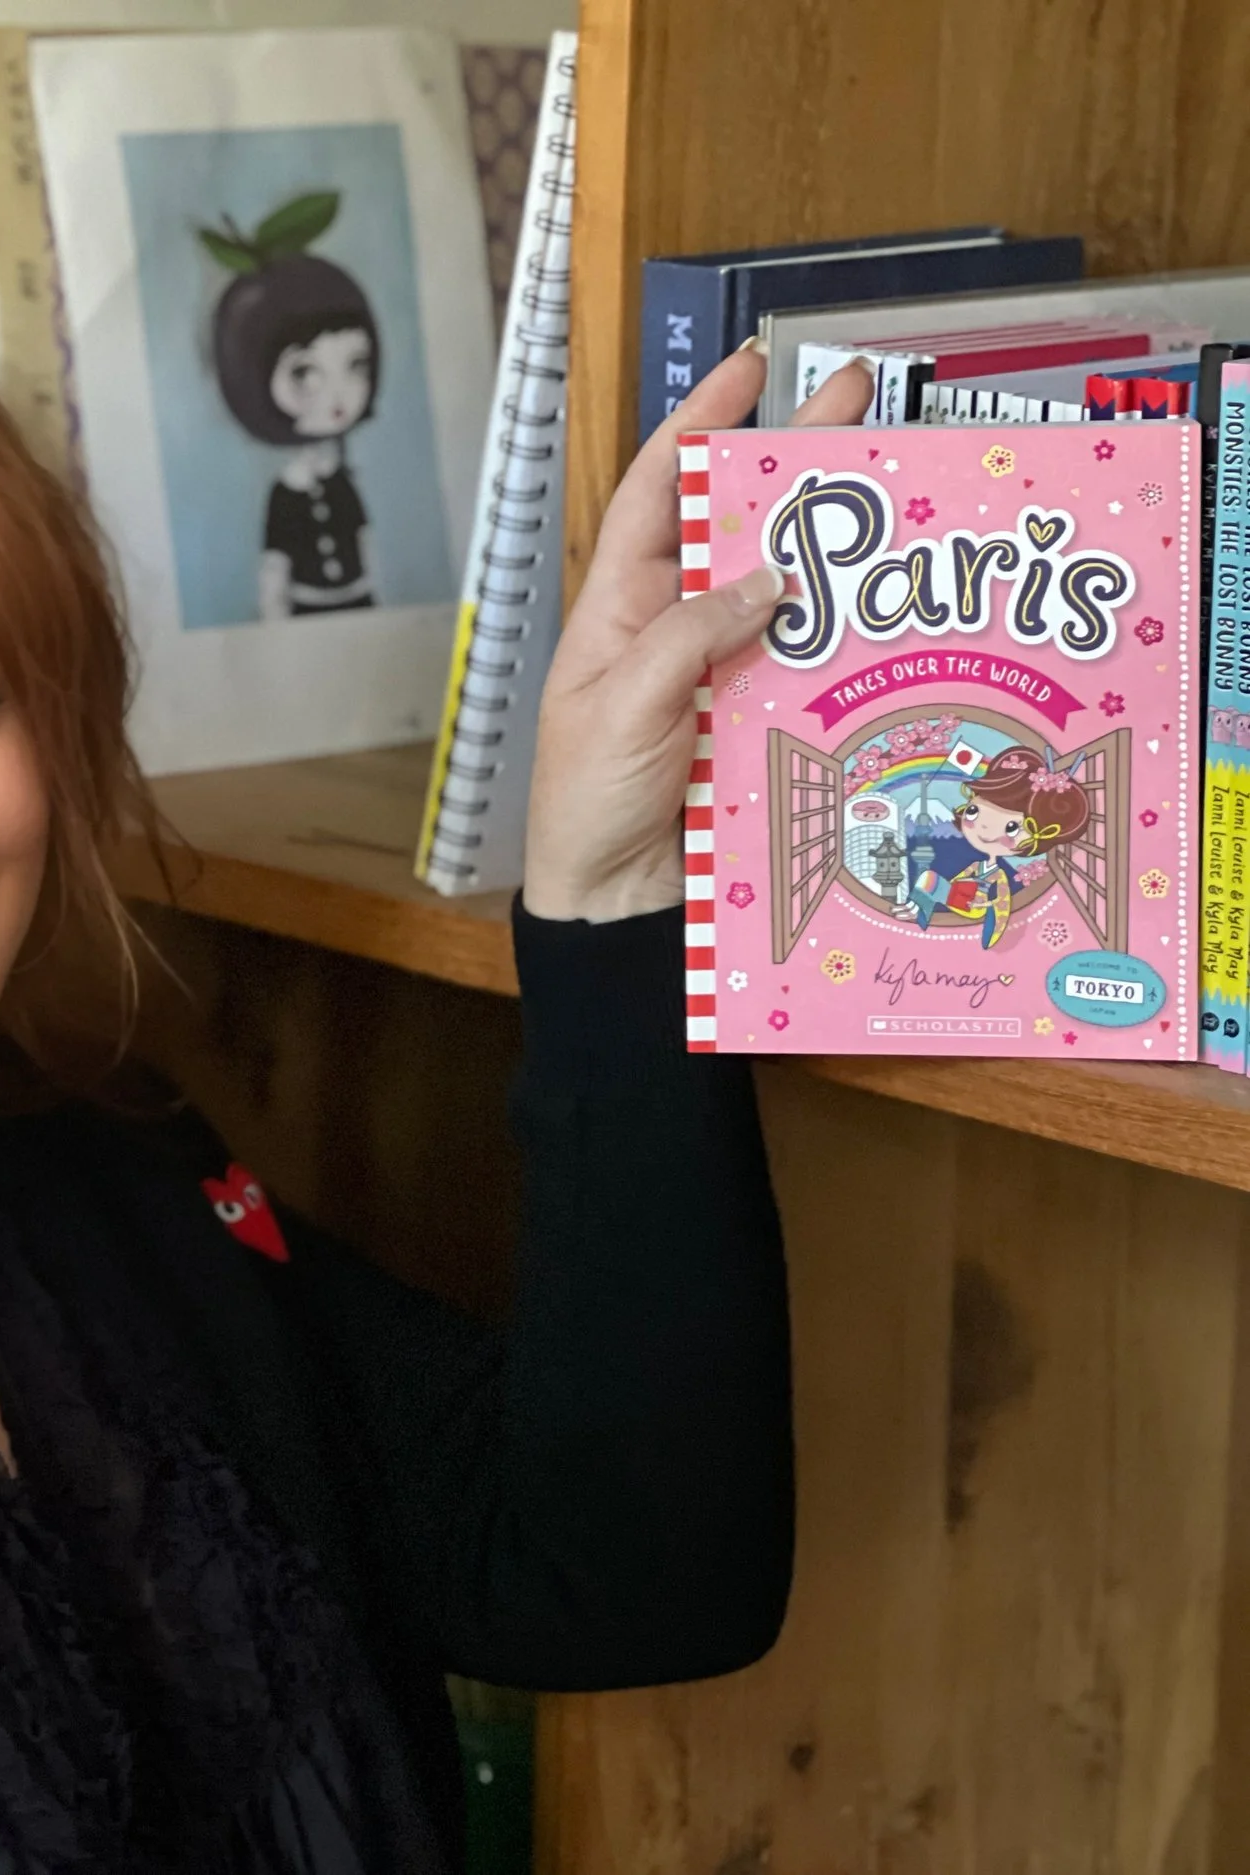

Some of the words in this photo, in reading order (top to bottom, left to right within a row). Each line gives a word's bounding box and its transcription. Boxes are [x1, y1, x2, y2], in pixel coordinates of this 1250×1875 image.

[1221, 401, 1246, 514] MONSTIES:
[1220, 522, 1240, 554] THE
[765, 476, 1129, 662] Paris
[1218, 563, 1239, 611] LOST
[1214, 617, 1236, 691] BUNNY
[831, 669, 887, 707] TAKES
[892, 660, 939, 682] OVER
[945, 656, 982, 677] THE
[989, 662, 1052, 703] WORLD
[1212, 785, 1231, 827] Zanni
[1207, 884, 1224, 896] &
[1230, 889, 1245, 901] &
[1205, 901, 1225, 935] Kyla
[1228, 907, 1245, 941] Kyla
[1202, 941, 1225, 974] May
[1225, 947, 1244, 980] May
[1073, 980, 1135, 1000] TOKYO
[890, 1020, 1017, 1033] SCHOLASTIC
